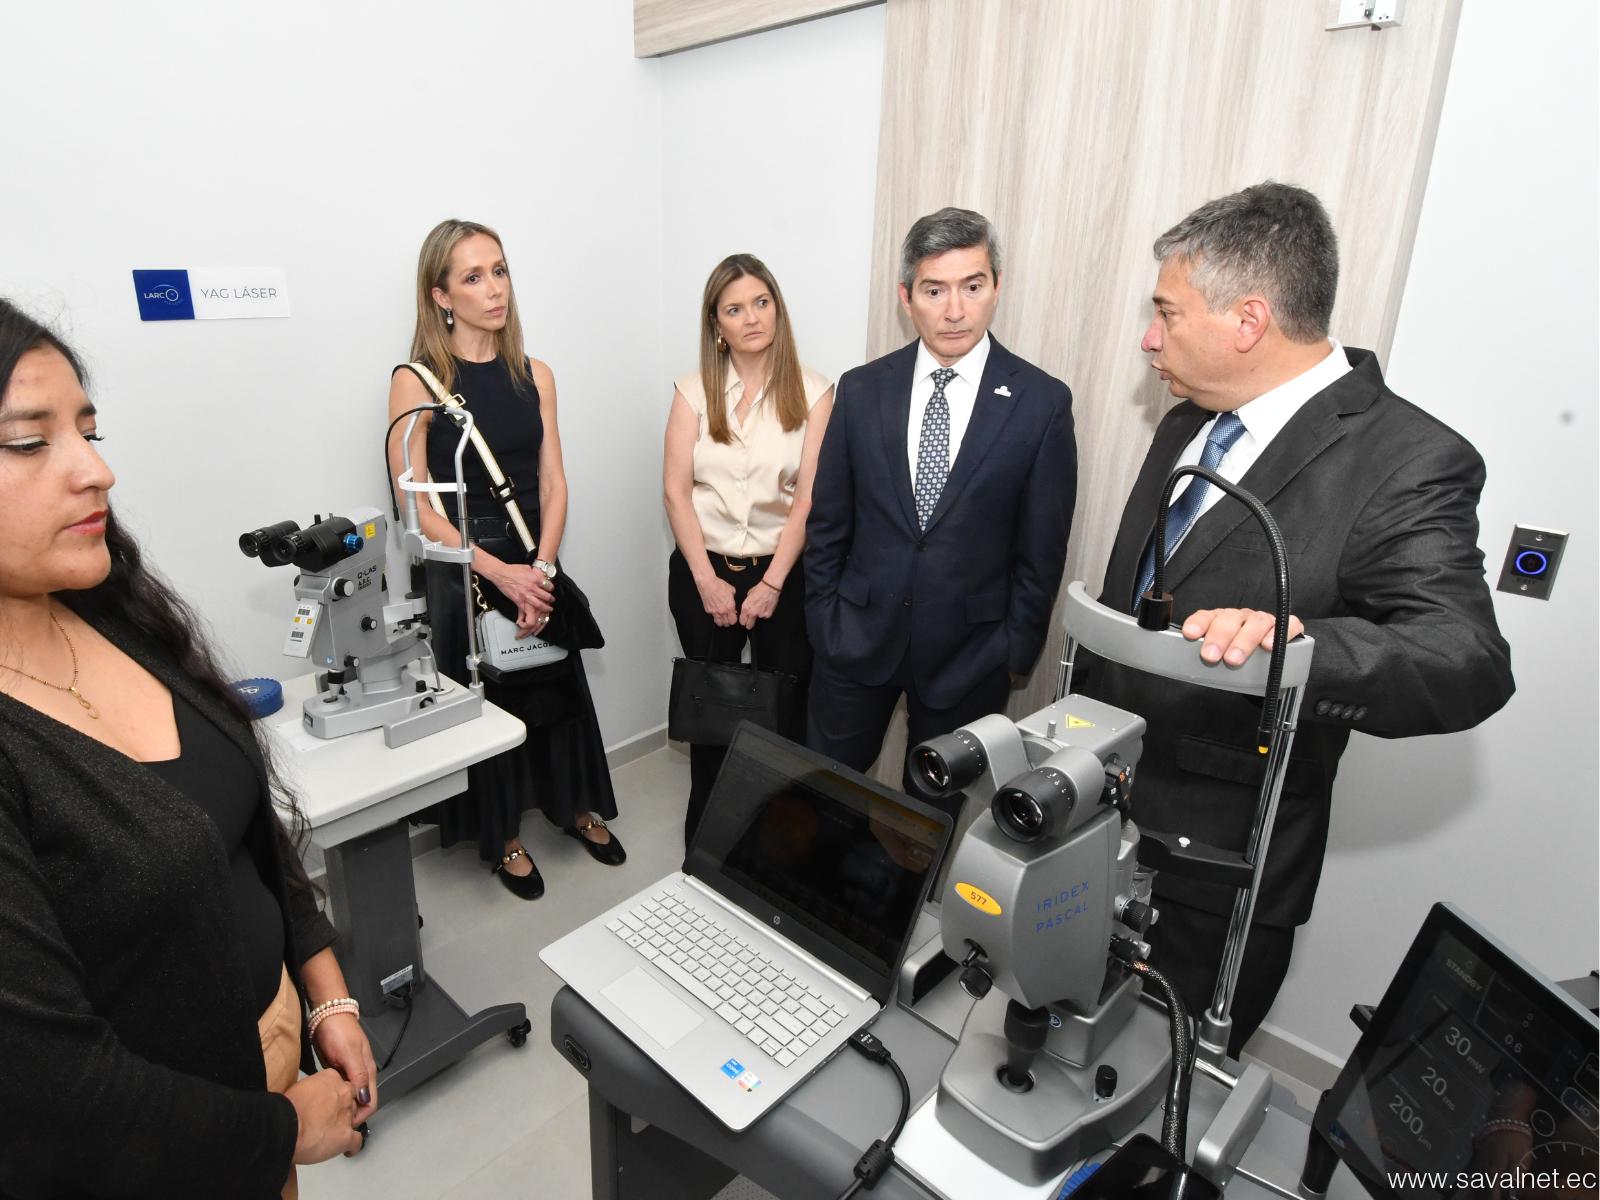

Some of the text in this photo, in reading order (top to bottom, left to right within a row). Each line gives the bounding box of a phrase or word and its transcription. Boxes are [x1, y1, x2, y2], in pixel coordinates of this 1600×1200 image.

[200, 285, 278, 299] YAG LÁSER
[500, 646, 525, 656] MARC
[970, 891, 987, 906] 577
[1036, 880, 1089, 913] IRIDEX
[1035, 902, 1089, 934] PASCAL
[1445, 958, 1483, 992] STANDBY
[1443, 1026, 1472, 1057] 30
[1504, 1033, 1523, 1054] 0.6
[1420, 1066, 1448, 1097] 20
[1388, 1094, 1425, 1135] 200
